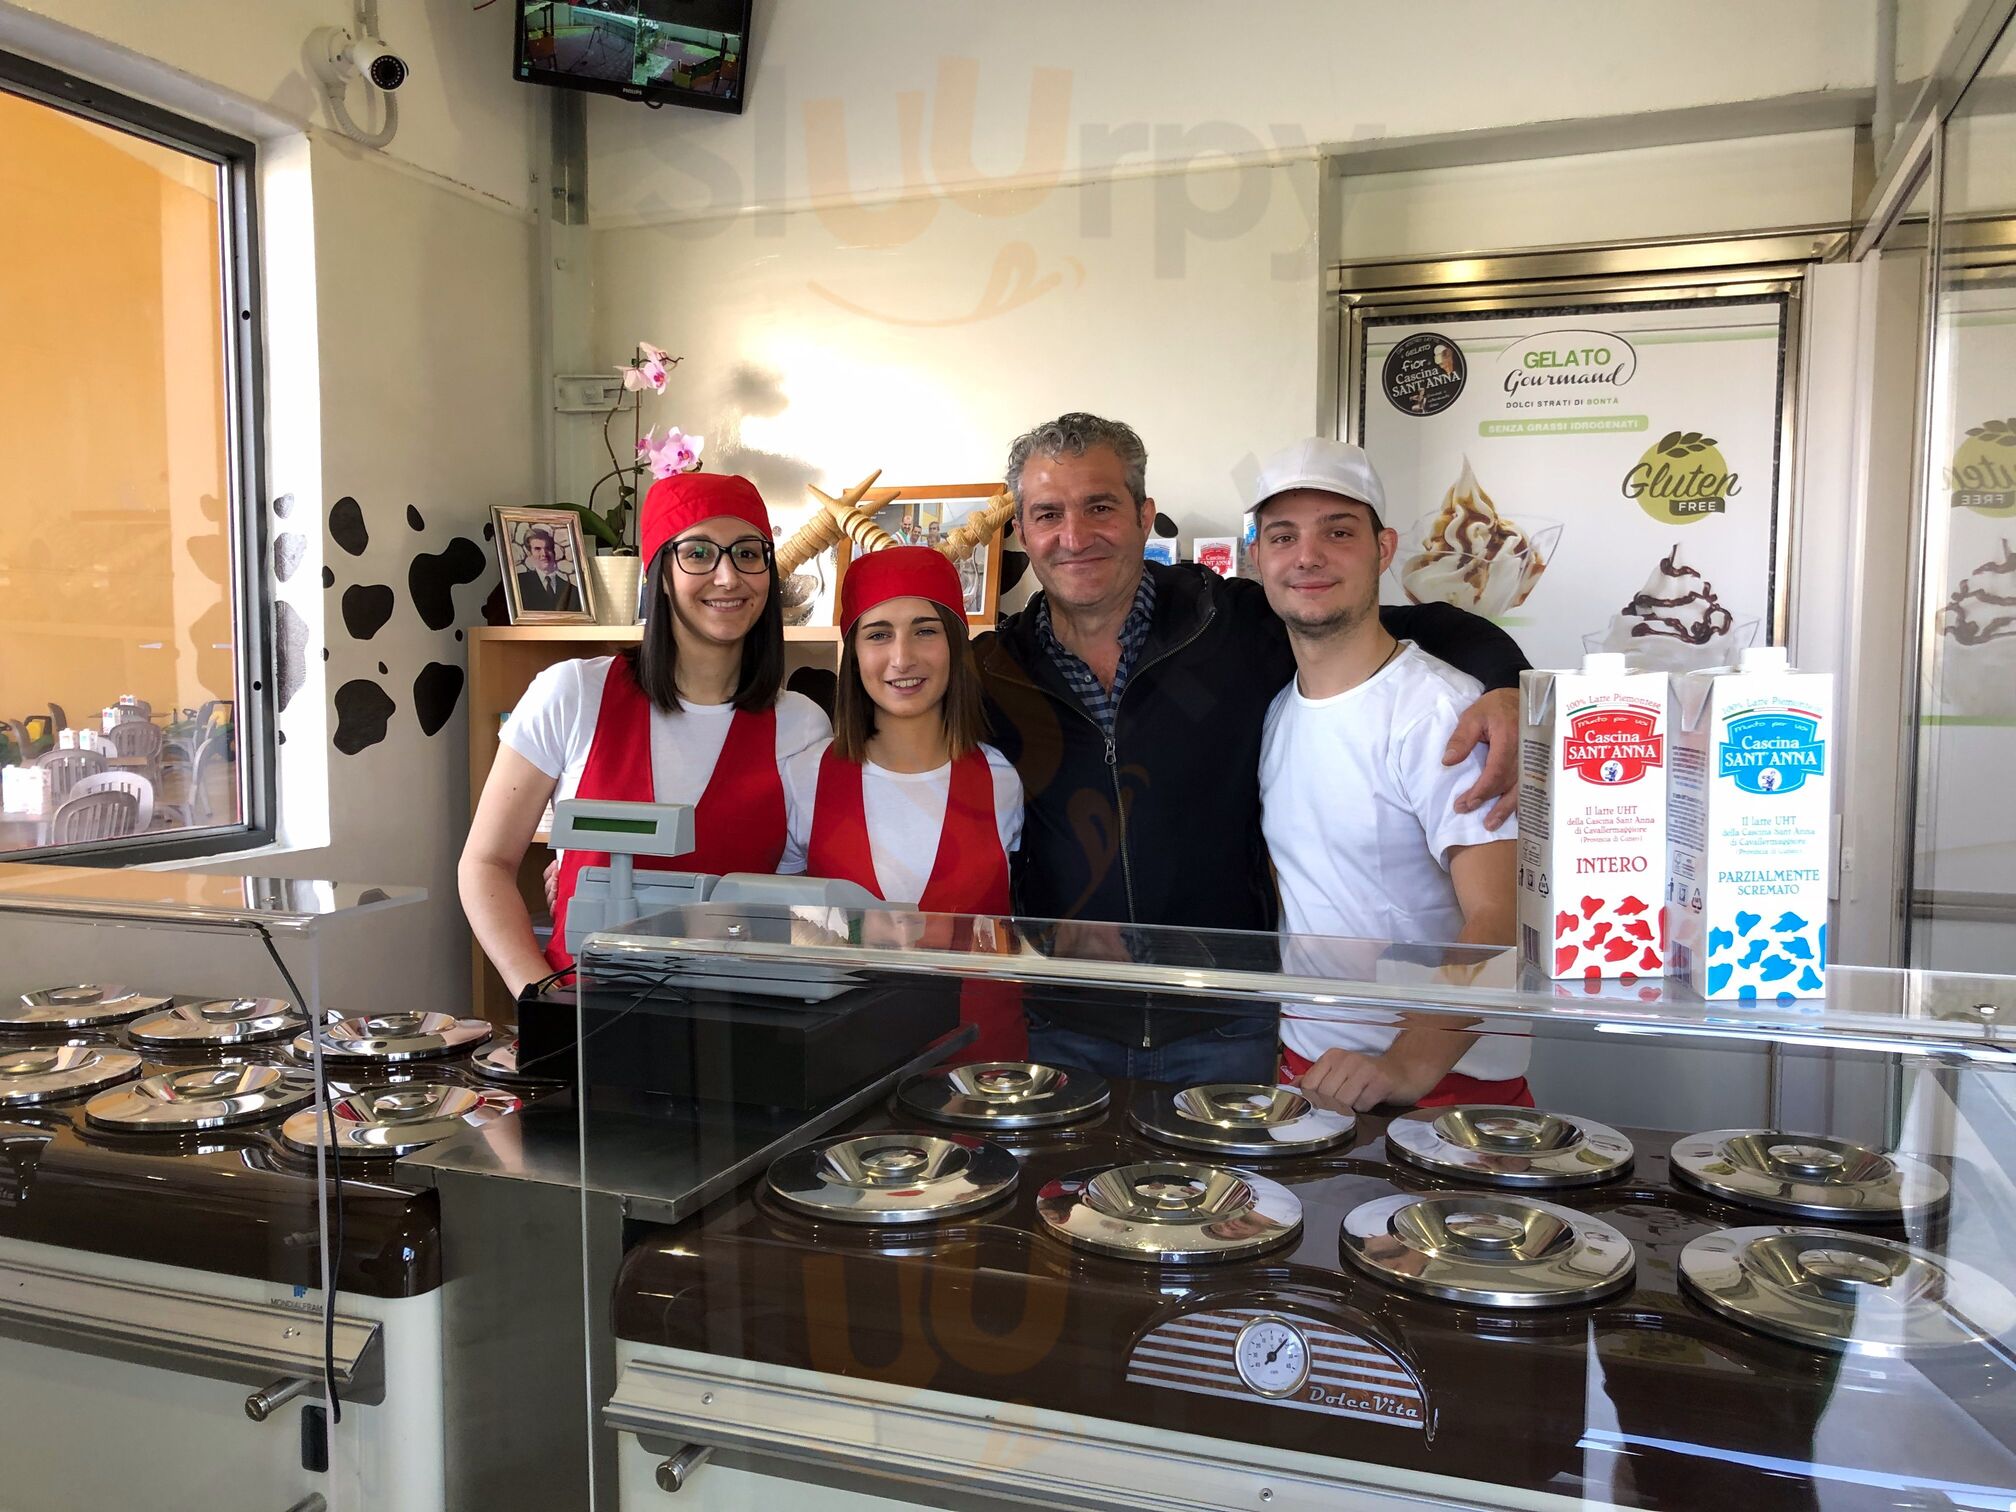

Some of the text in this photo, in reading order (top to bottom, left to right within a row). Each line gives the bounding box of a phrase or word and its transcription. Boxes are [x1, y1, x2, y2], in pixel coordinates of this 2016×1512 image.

[1523, 348, 1611, 369] GELATO
[1395, 367, 1439, 385] Cascina
[1503, 362, 1625, 398] Gourmand
[1505, 401, 1534, 409] DOLCI
[1537, 400, 1571, 408] STRATI
[1488, 419, 1638, 434] SENZA GRASSI IDROGENATI
[1621, 462, 1743, 499] Gluten
[1678, 501, 1716, 512] FREE
[1588, 695, 1611, 704] Latte
[1584, 729, 1640, 744] Cascina
[1741, 735, 1800, 750] Cascina
[1617, 805, 1638, 815] UHT
[1775, 815, 1797, 825] UHT
[1576, 855, 1648, 874] INTERO
[1718, 869, 1820, 883] PARZIALMENTE
[1737, 883, 1800, 896] SCREMATO
